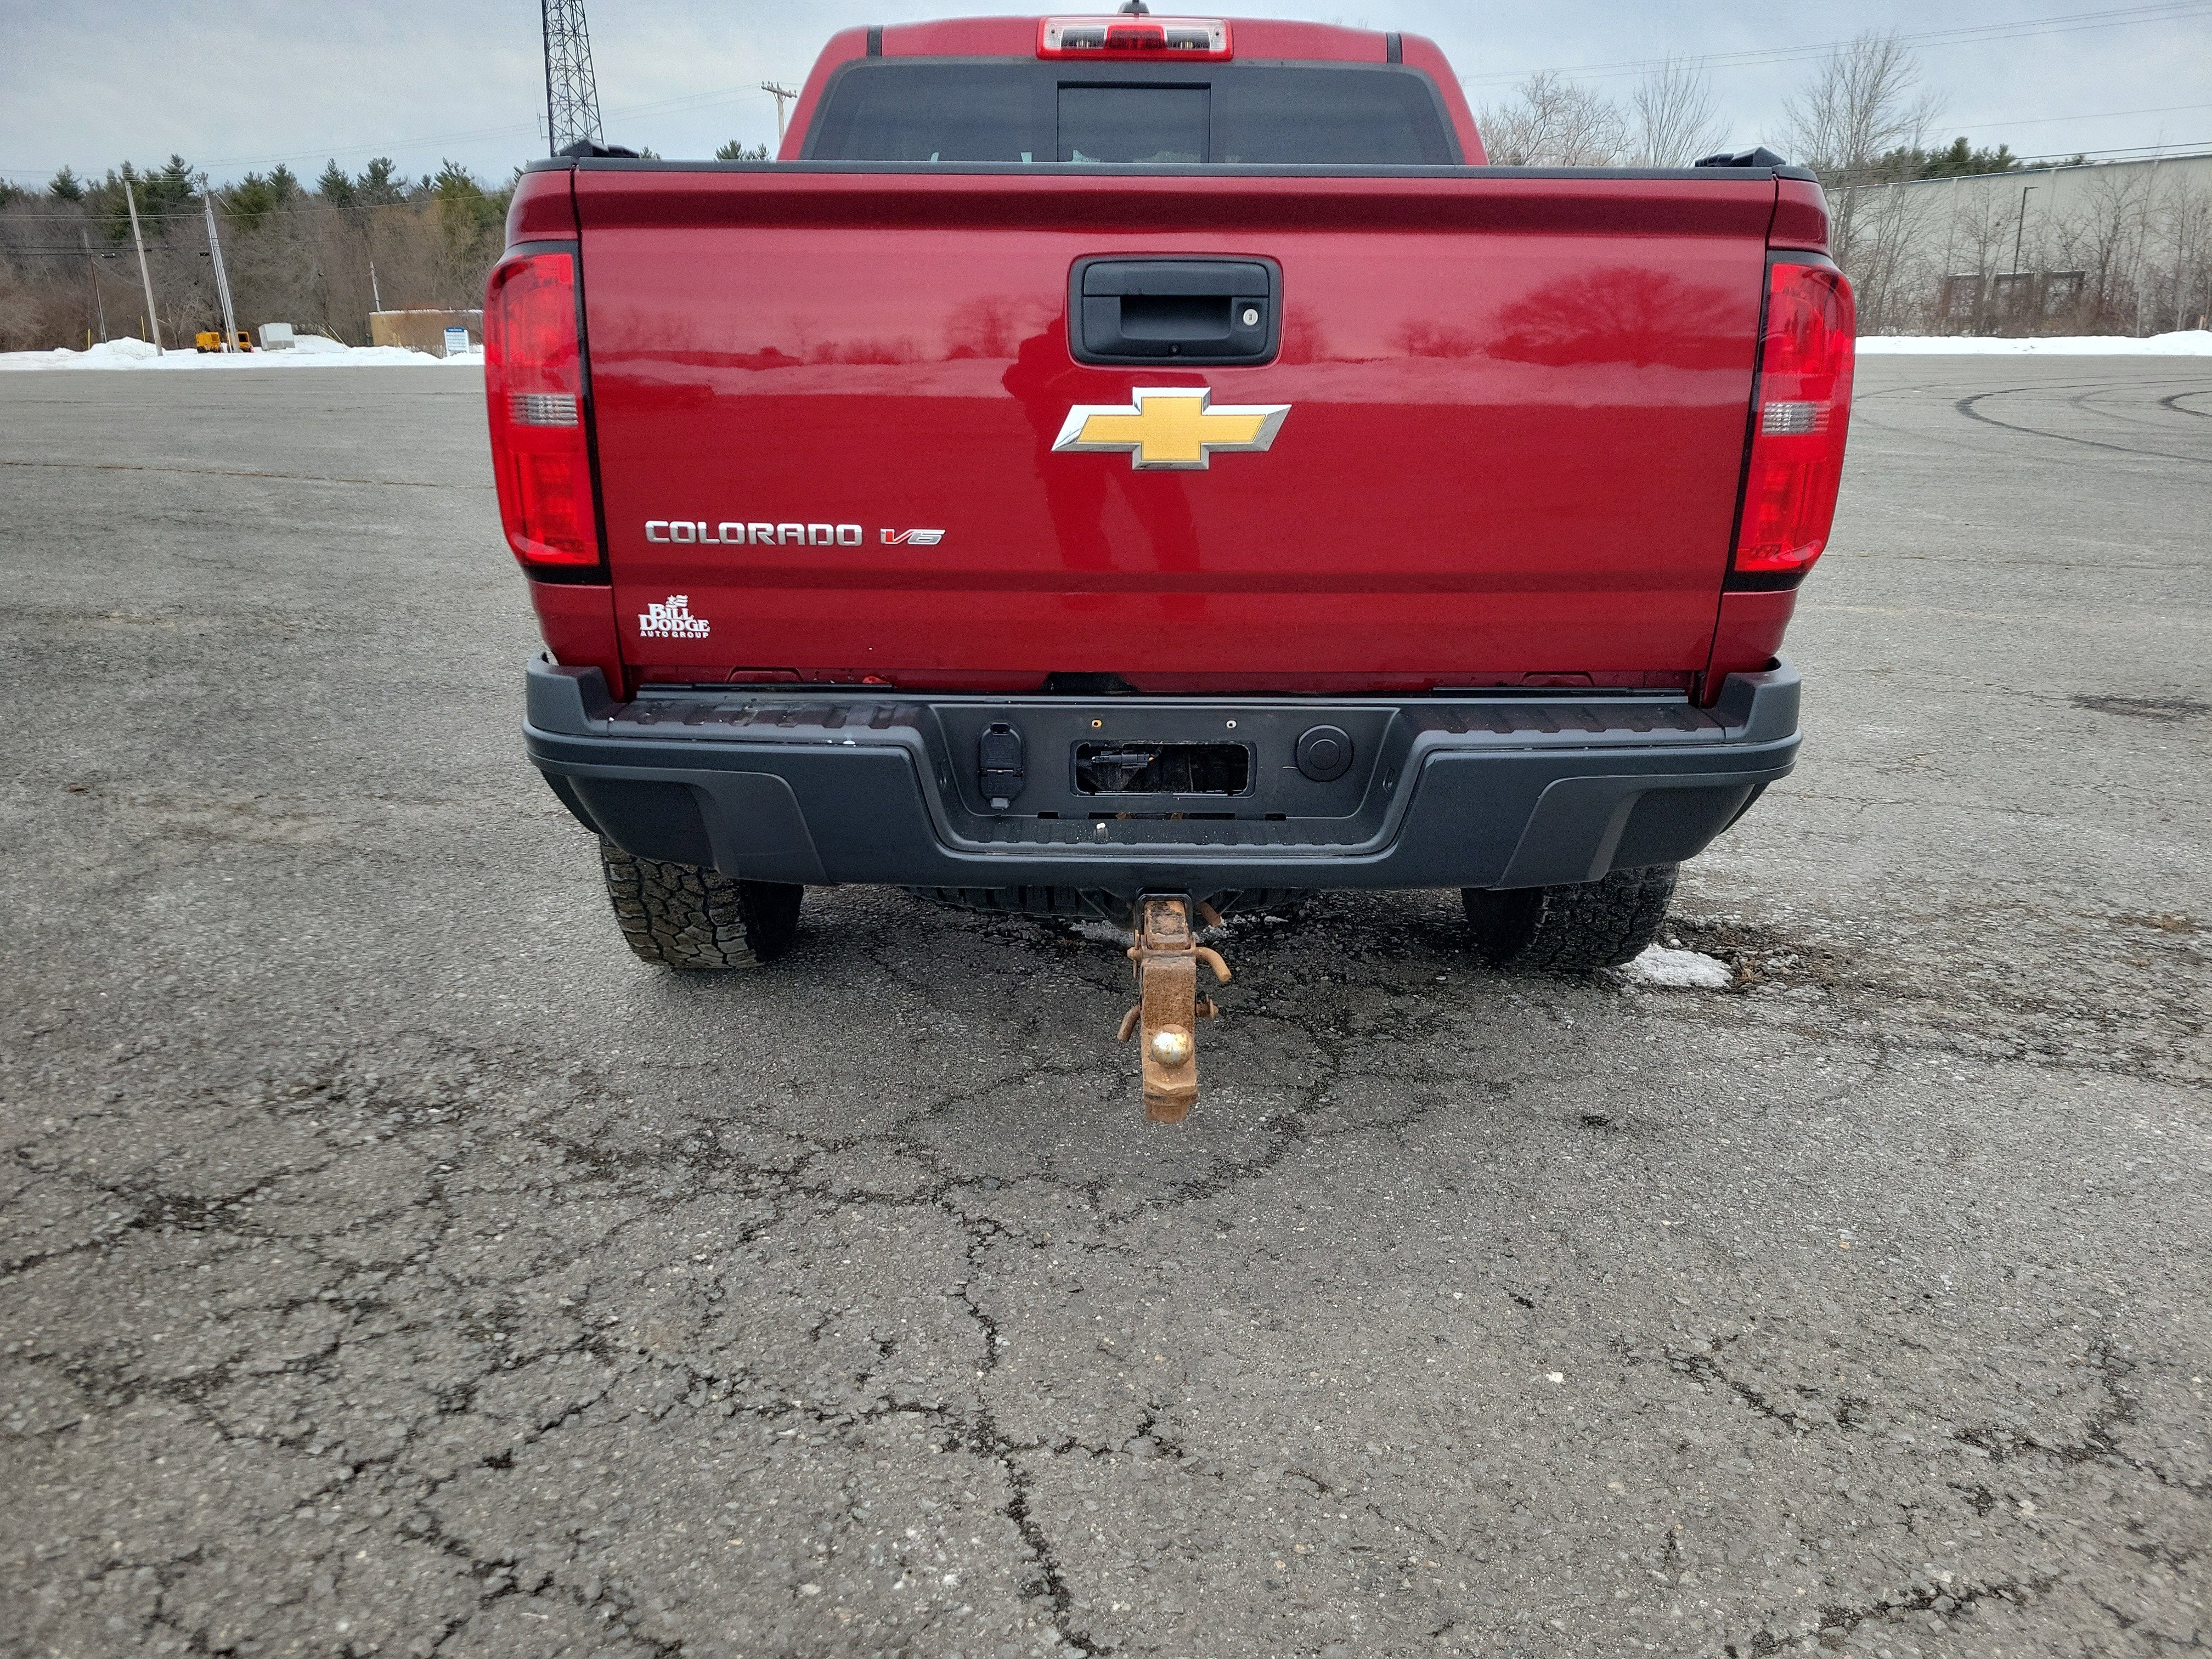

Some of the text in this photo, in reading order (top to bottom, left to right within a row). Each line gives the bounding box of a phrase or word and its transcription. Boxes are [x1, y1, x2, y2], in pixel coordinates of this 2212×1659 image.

[645, 521, 946, 546] COLORADO V6
[647, 603, 695, 620] BILL
[637, 614, 710, 632] DODGE
